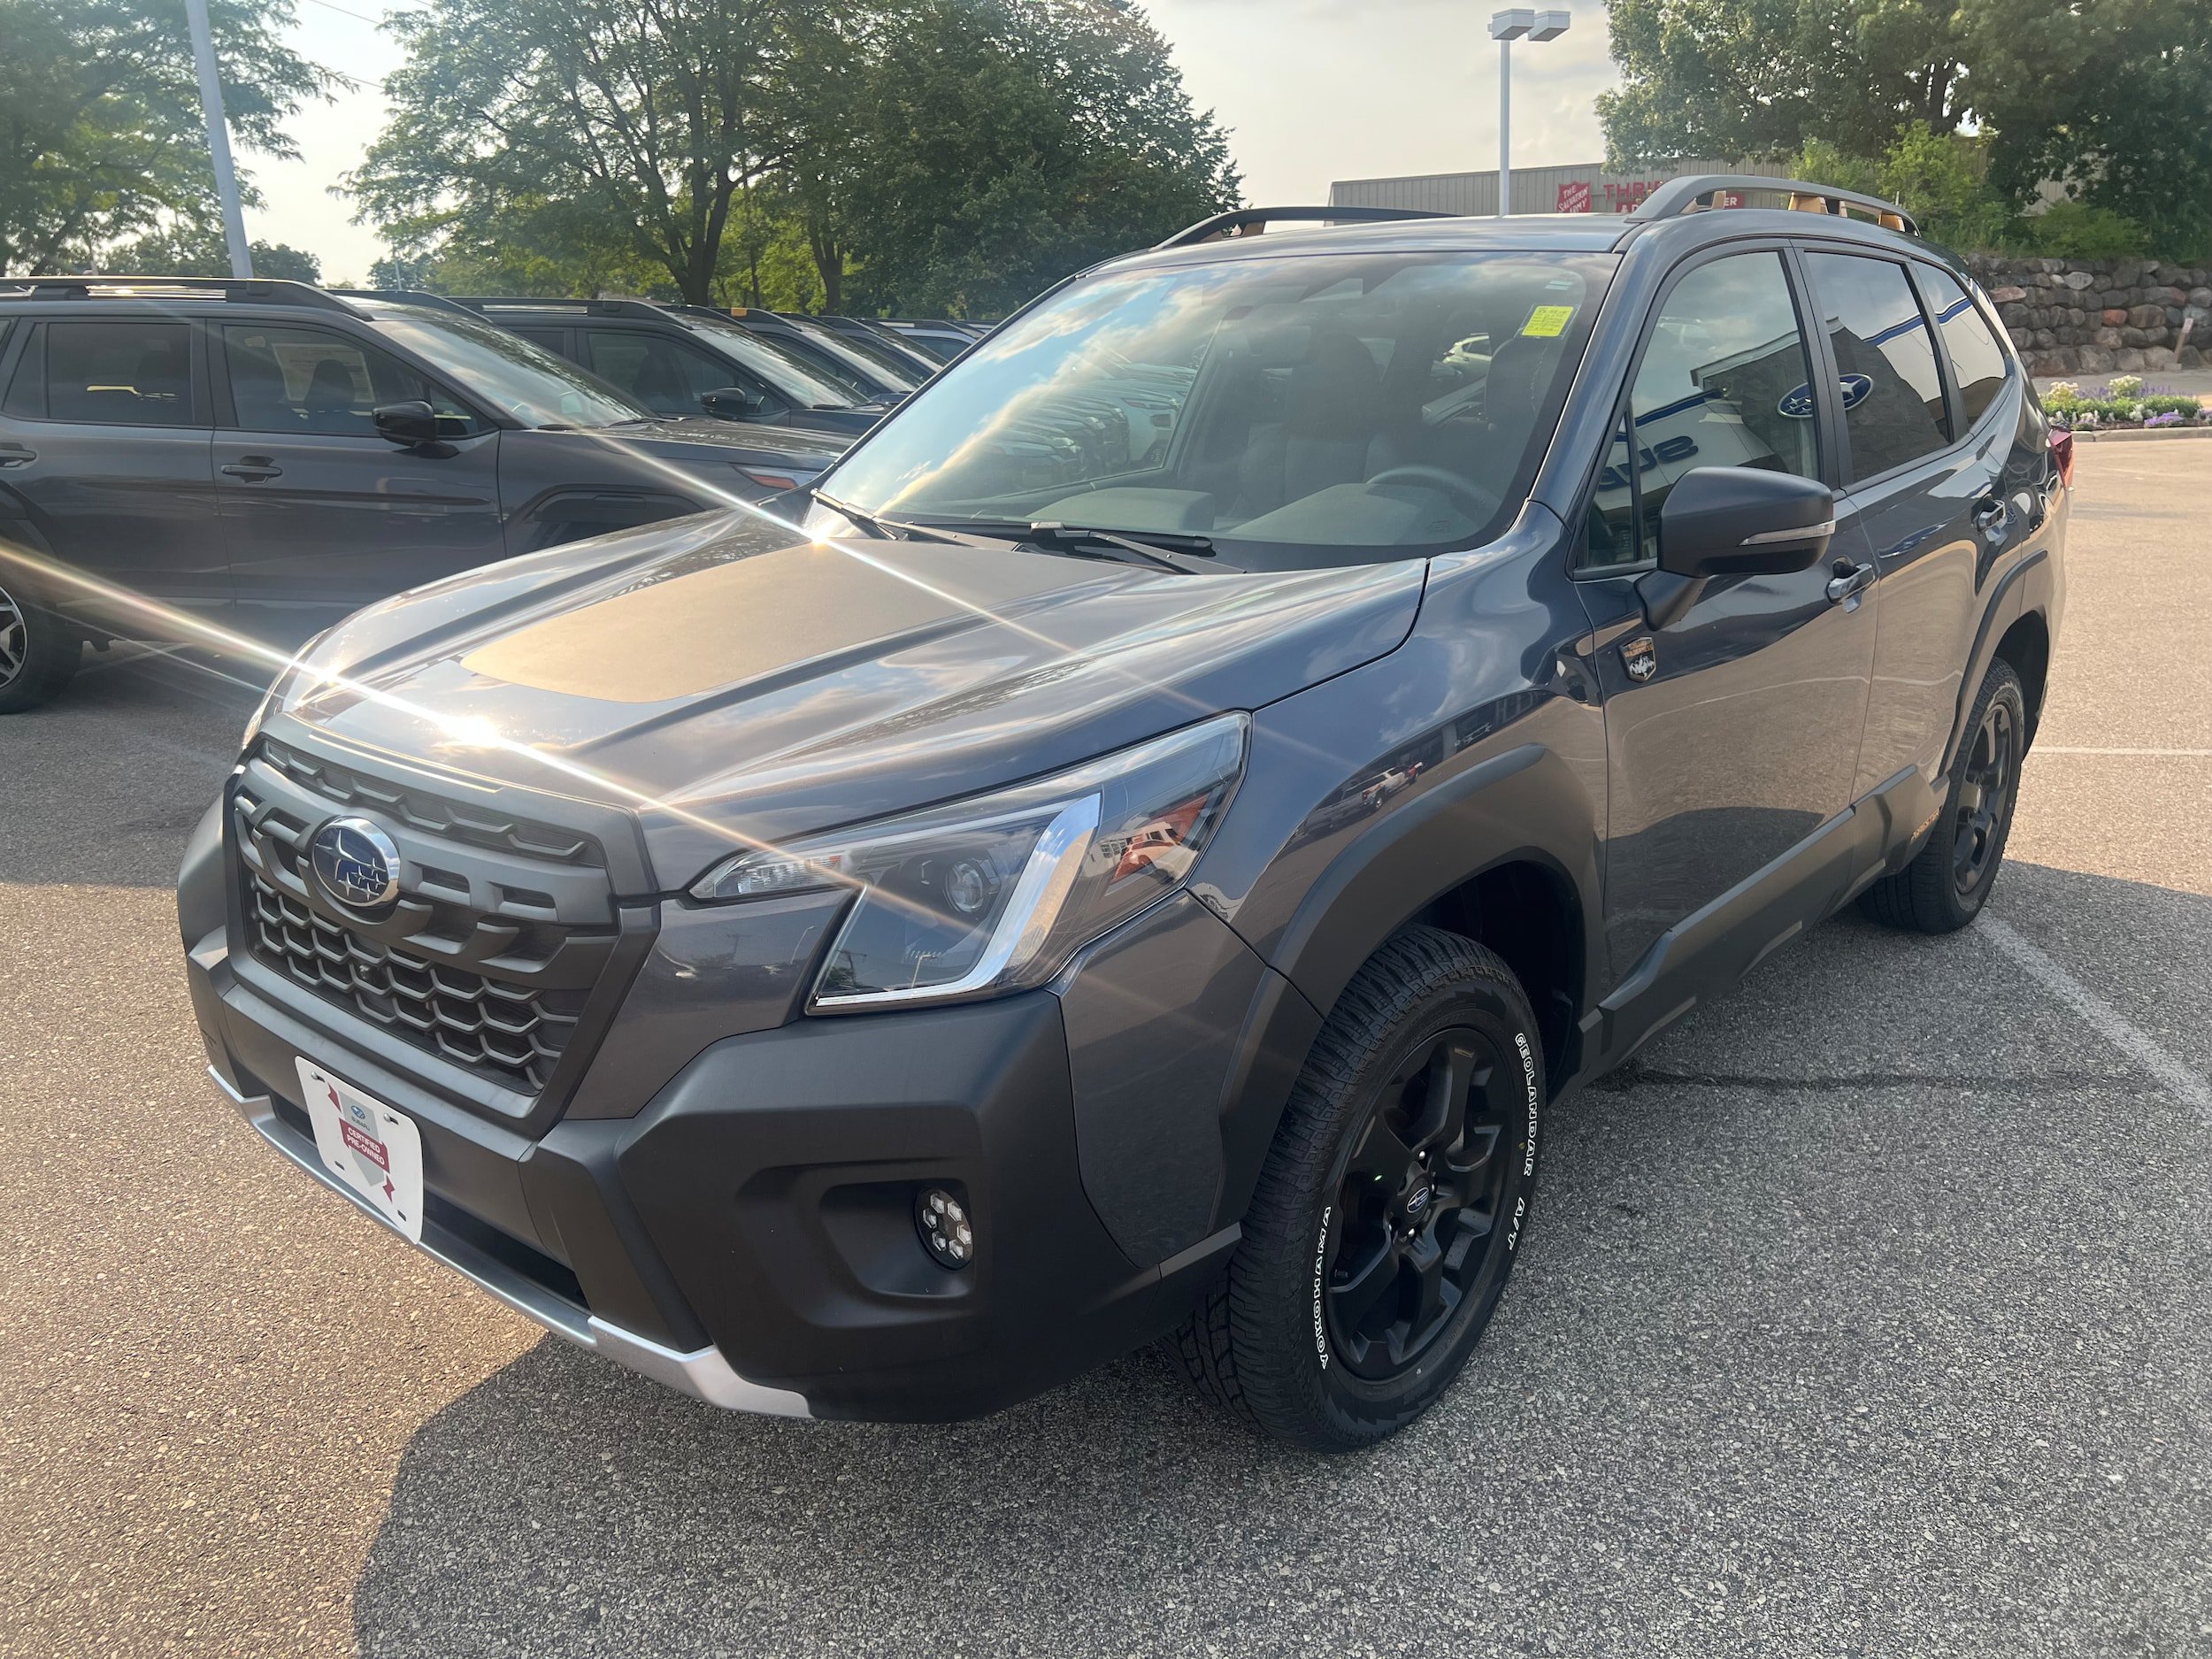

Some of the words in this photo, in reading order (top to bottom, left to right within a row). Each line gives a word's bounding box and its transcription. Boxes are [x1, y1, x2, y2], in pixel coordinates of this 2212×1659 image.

[1563, 185, 1576, 198] THE
[1515, 1033, 1538, 1177] GEOLANDAR
[346, 1133, 385, 1165] PRE-OWNED
[348, 1126, 380, 1154] CERTIFIED
[1508, 1197, 1525, 1251] A/T
[1313, 1206, 1332, 1370] YOKOHAMA
